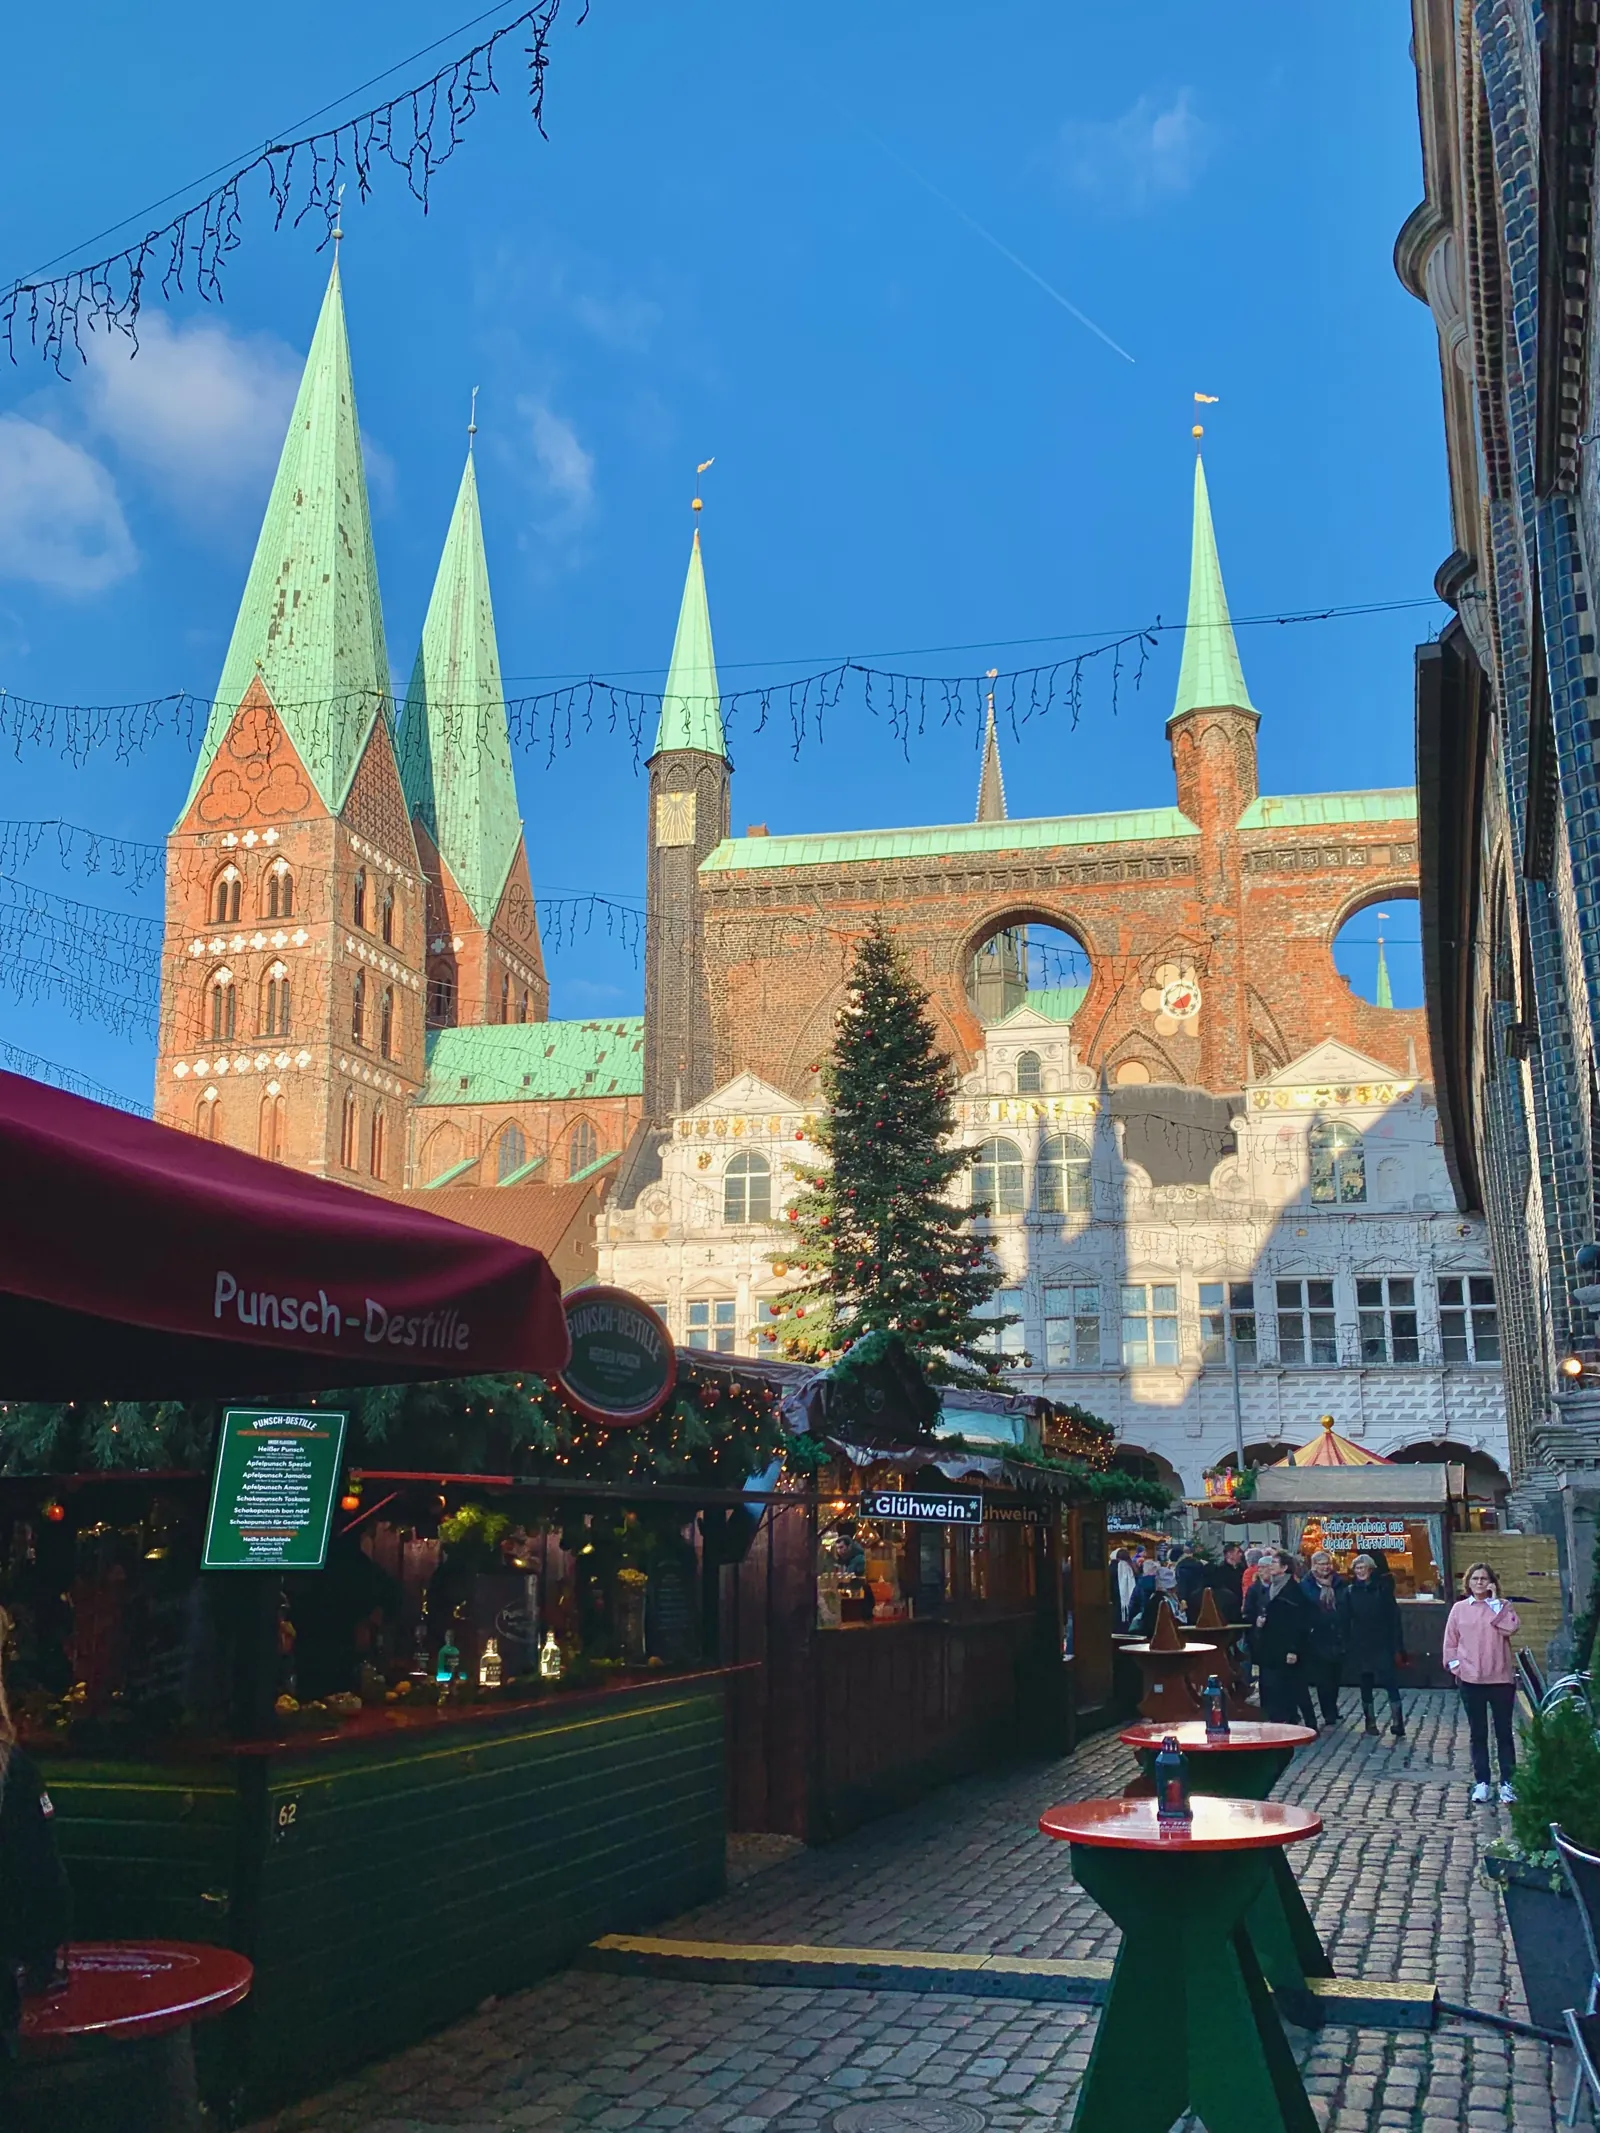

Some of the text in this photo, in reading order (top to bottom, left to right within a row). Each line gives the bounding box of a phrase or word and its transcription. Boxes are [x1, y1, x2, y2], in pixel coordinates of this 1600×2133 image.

[213, 1270, 470, 1352] Punsch-Destille
[252, 1416, 318, 1431] PUNSCH-DESTILLE
[246, 1460, 287, 1468] Apfelpunsch
[287, 1461, 312, 1469] Spezial
[242, 1472, 283, 1480] Apfelpunsch
[242, 1483, 283, 1492] Apfelpunsch
[236, 1495, 283, 1503] Schokopunsch
[233, 1507, 281, 1515] Schokopunsch
[876, 1496, 965, 1518] Glühwein
[229, 1519, 272, 1527] Schokopunsch
[1321, 1518, 1404, 1533] Kräuterbonbons aus
[1323, 1535, 1405, 1552] eigener Herstellung
[279, 1803, 296, 1826] 62
